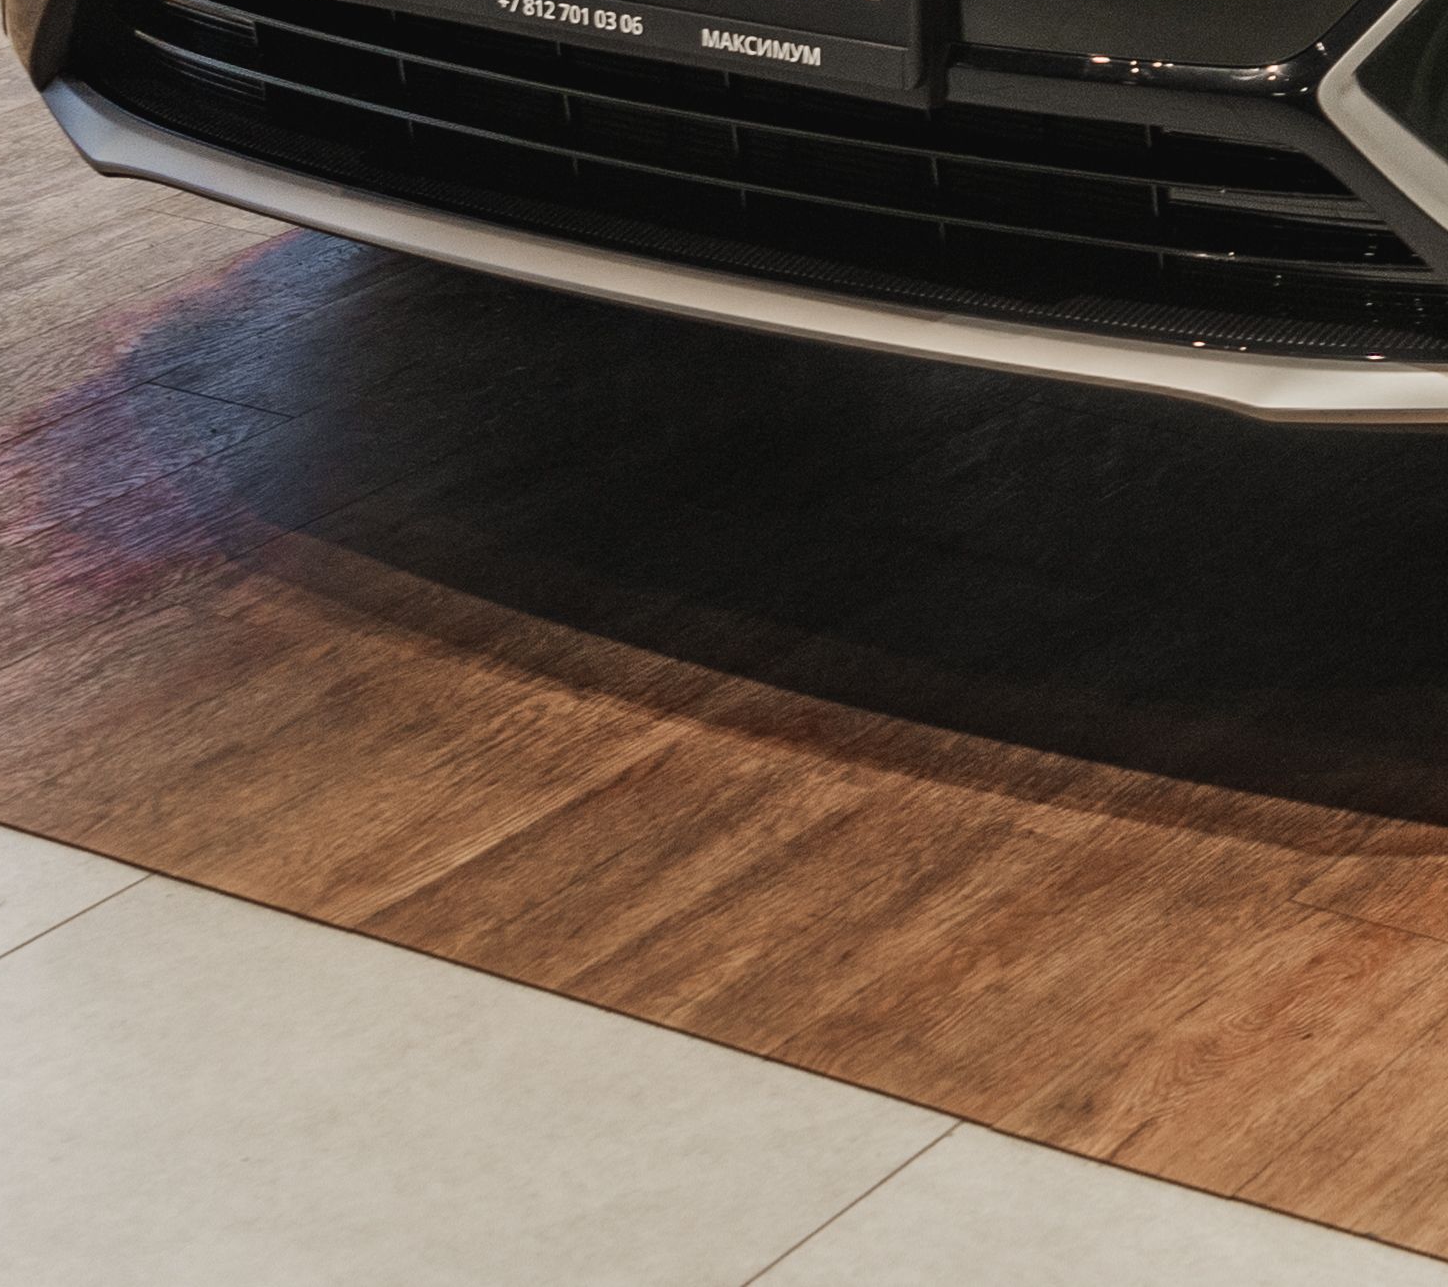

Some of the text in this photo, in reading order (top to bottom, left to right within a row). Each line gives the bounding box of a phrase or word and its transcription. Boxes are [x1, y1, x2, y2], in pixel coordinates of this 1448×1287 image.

[558, 2, 590, 26] 701
[593, 9, 618, 31] 03
[619, 13, 644, 36] 06
[701, 28, 822, 67] МАКСИМУМ
